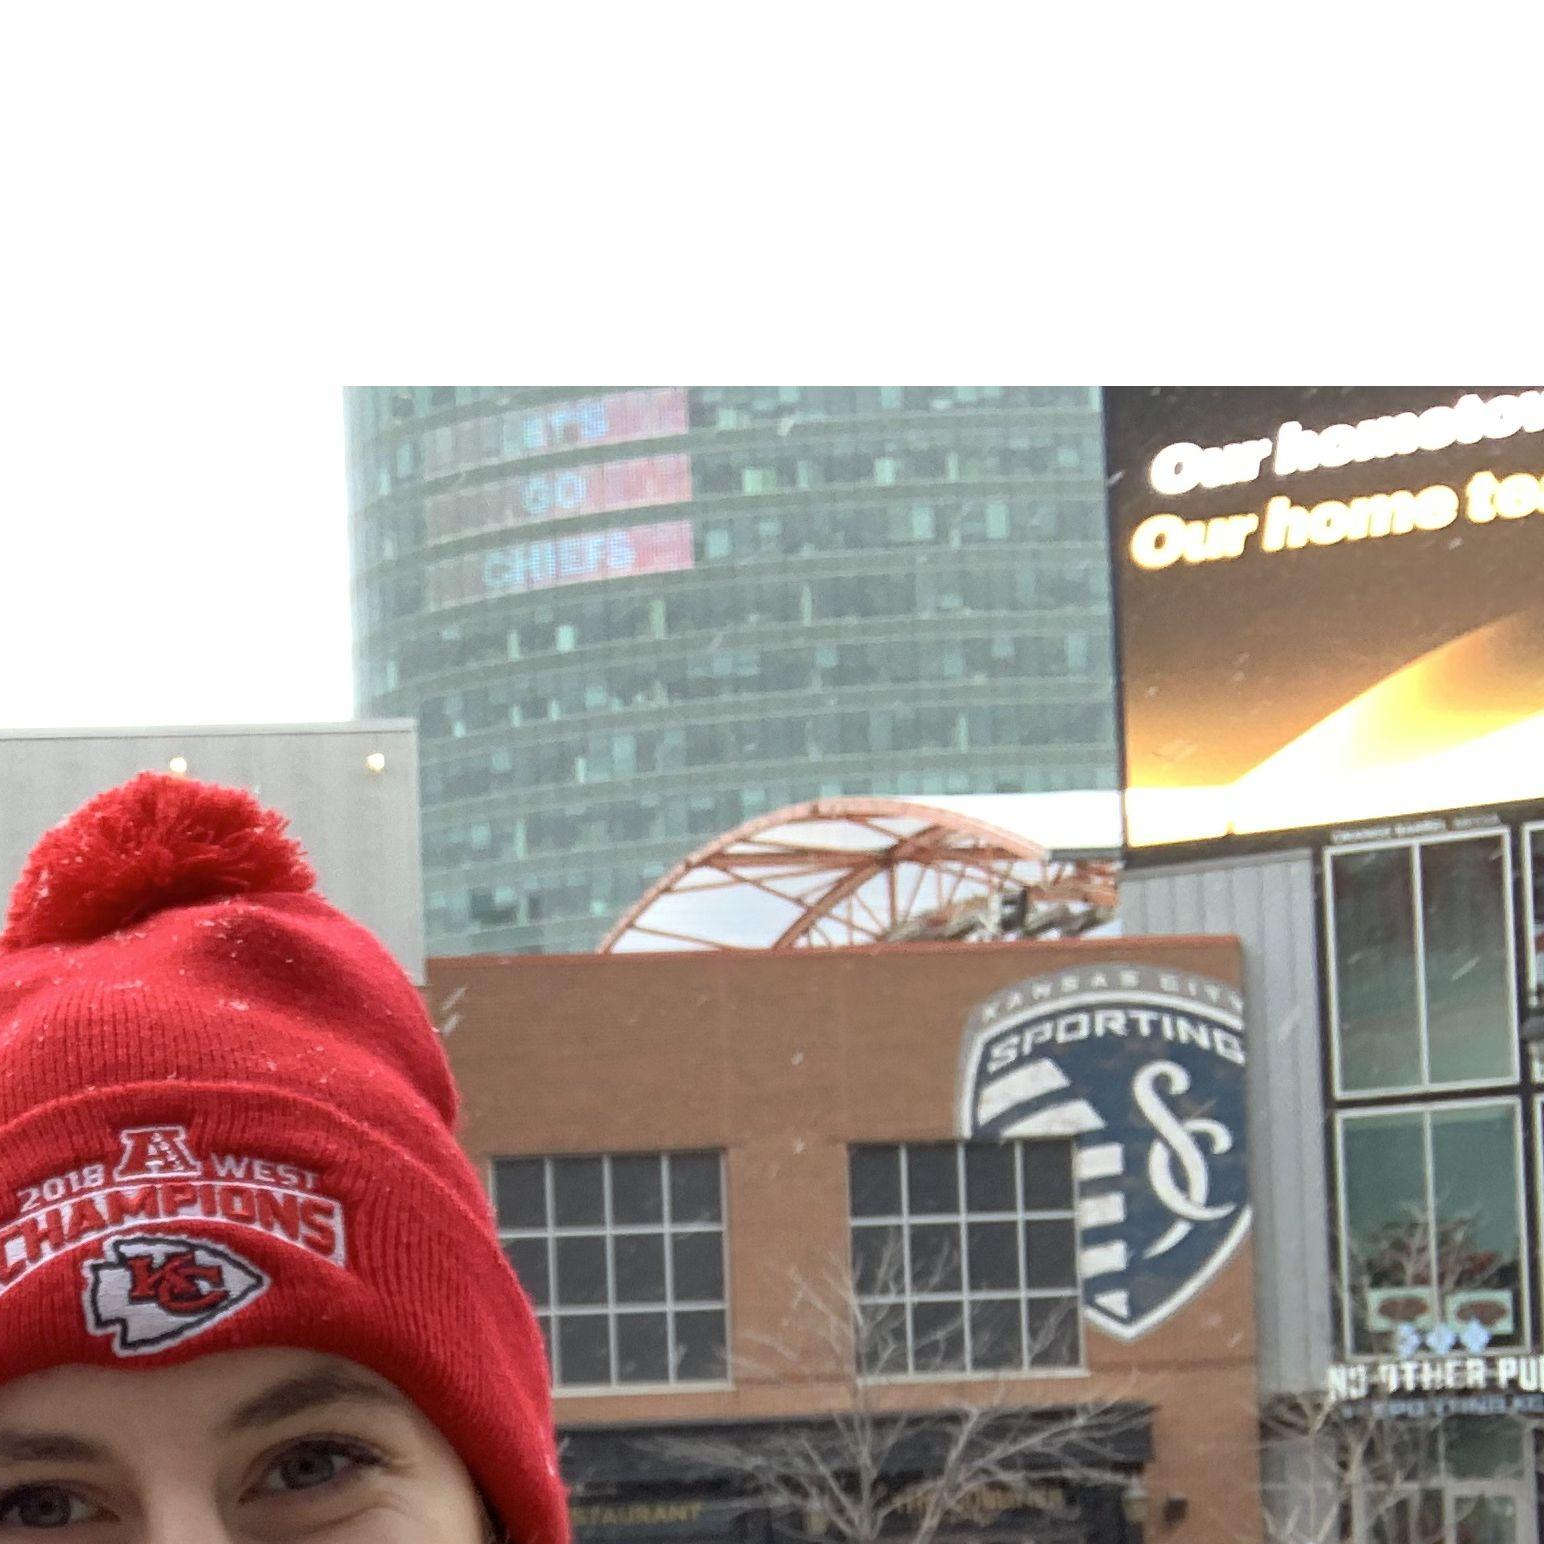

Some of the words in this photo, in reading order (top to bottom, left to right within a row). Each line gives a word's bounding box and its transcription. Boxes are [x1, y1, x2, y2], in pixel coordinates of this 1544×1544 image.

[521, 471, 588, 516] GO
[1149, 442, 1273, 495] Our
[1130, 513, 1259, 570] Our
[1262, 485, 1460, 552] home
[1465, 470, 1544, 524] te
[482, 530, 637, 588] CHIEFS
[981, 969, 1140, 1024] KANSAS
[1159, 973, 1245, 1012] CITY
[986, 1008, 1247, 1075] SPORTING
[15, 1162, 106, 1213] 2018
[208, 1152, 319, 1191] WEST
[1327, 1362, 1369, 1401] NO
[1378, 1357, 1488, 1394] OTHER
[1496, 1353, 1544, 1393] PU
